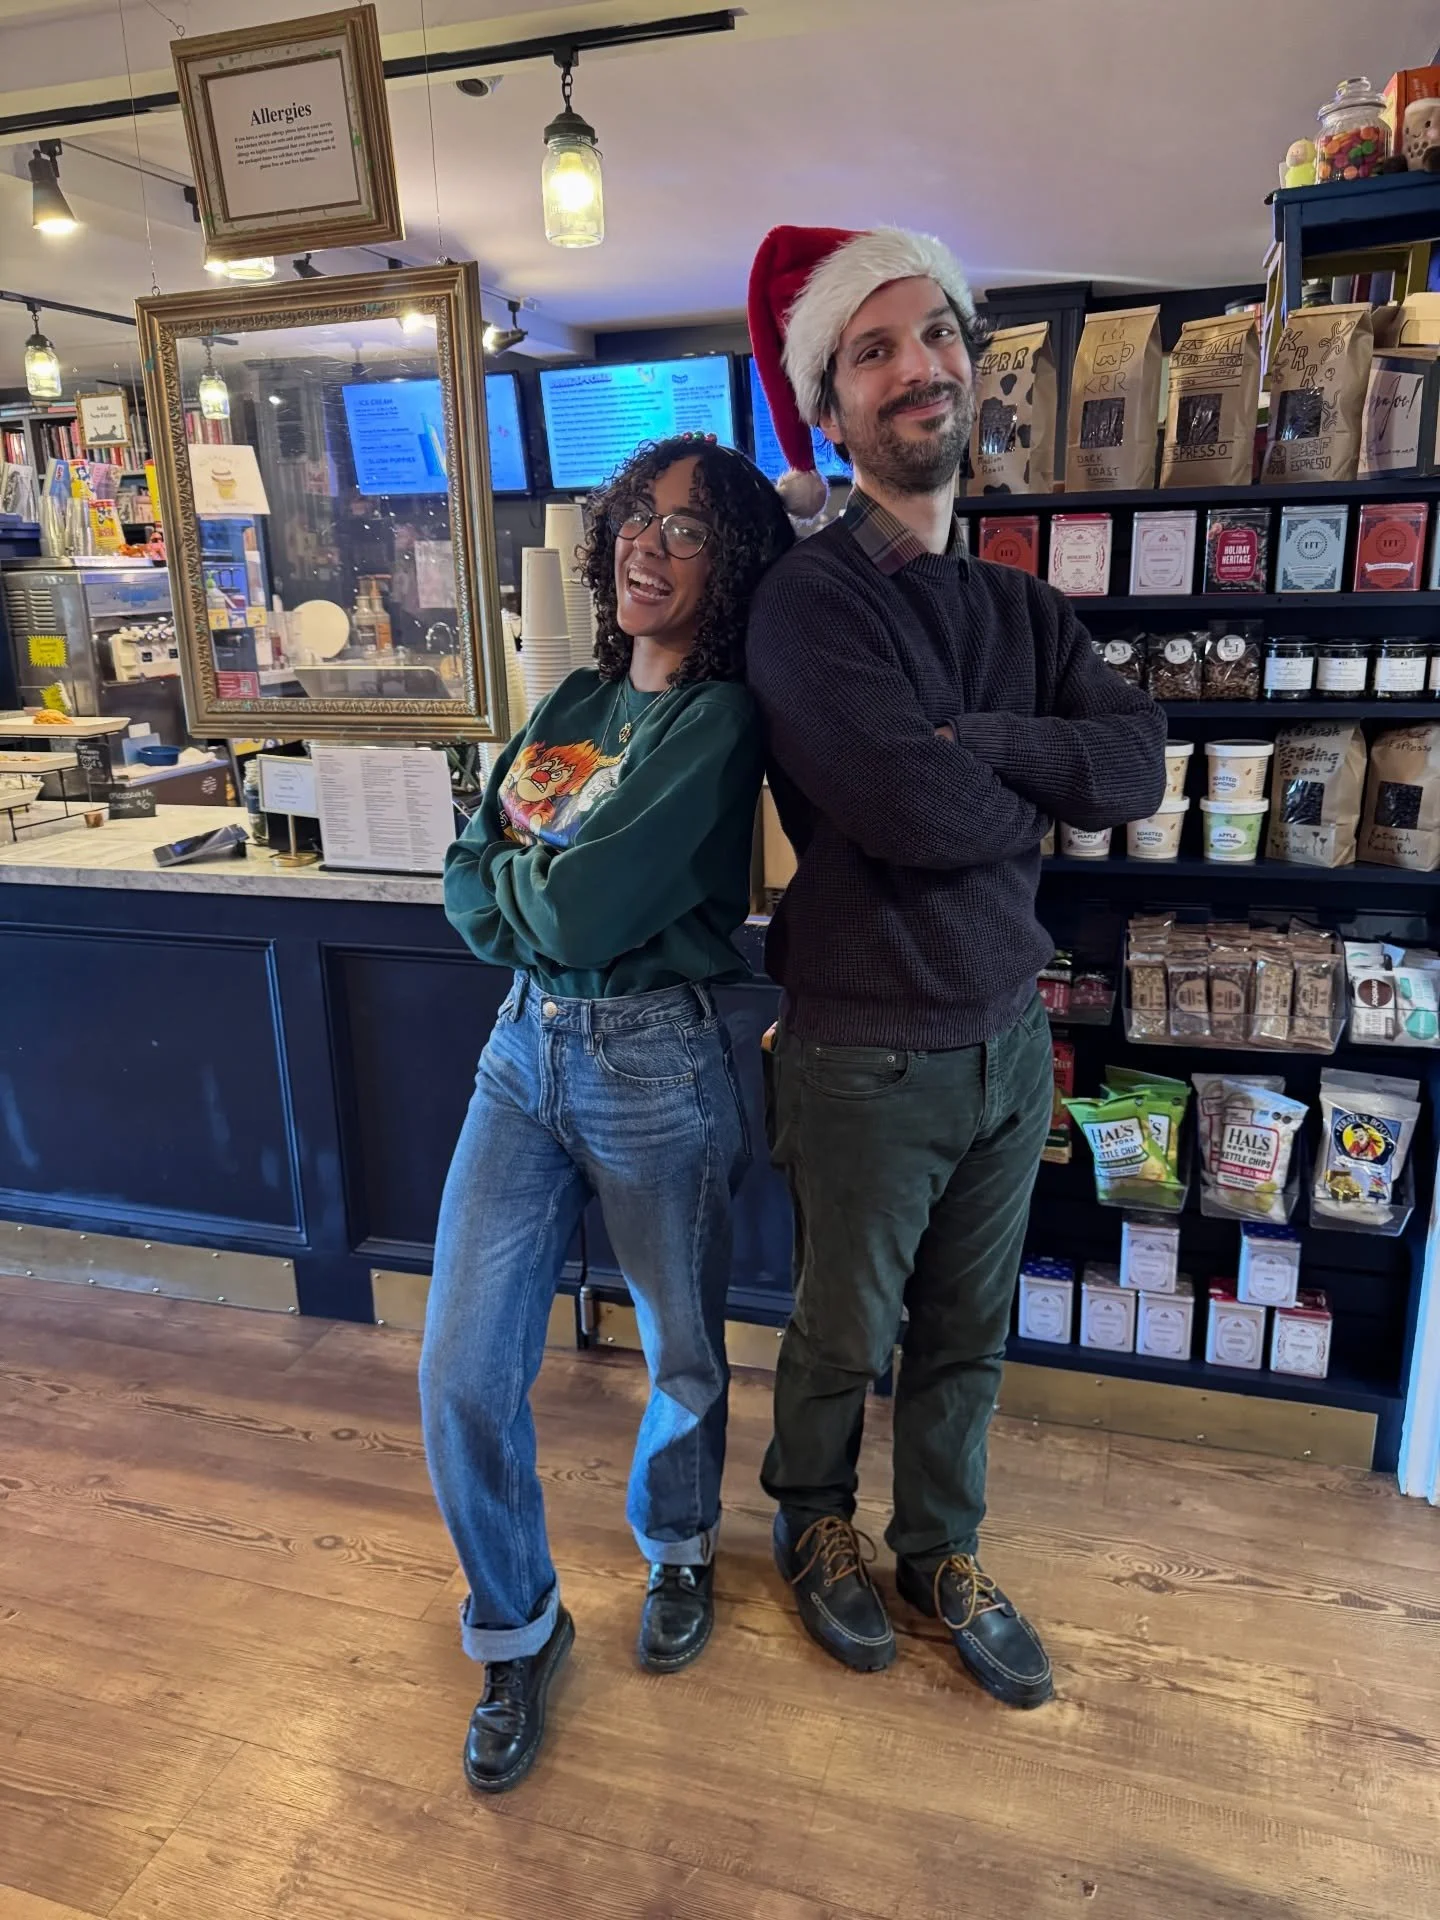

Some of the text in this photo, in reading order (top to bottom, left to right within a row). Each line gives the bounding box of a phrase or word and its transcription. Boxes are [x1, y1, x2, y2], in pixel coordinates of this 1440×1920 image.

[251, 102, 312, 126] Allergies
[981, 346, 1029, 375] KRR
[1084, 372, 1129, 394] KRR
[1221, 554, 1251, 565] HERITAGE
[1224, 545, 1250, 555] HOLIDAY
[1091, 1124, 1135, 1144] HAL'S
[1228, 1127, 1271, 1152] HAL'S
[1226, 1143, 1268, 1157] NEW YORK
[1248, 1156, 1271, 1169] CHIPS
